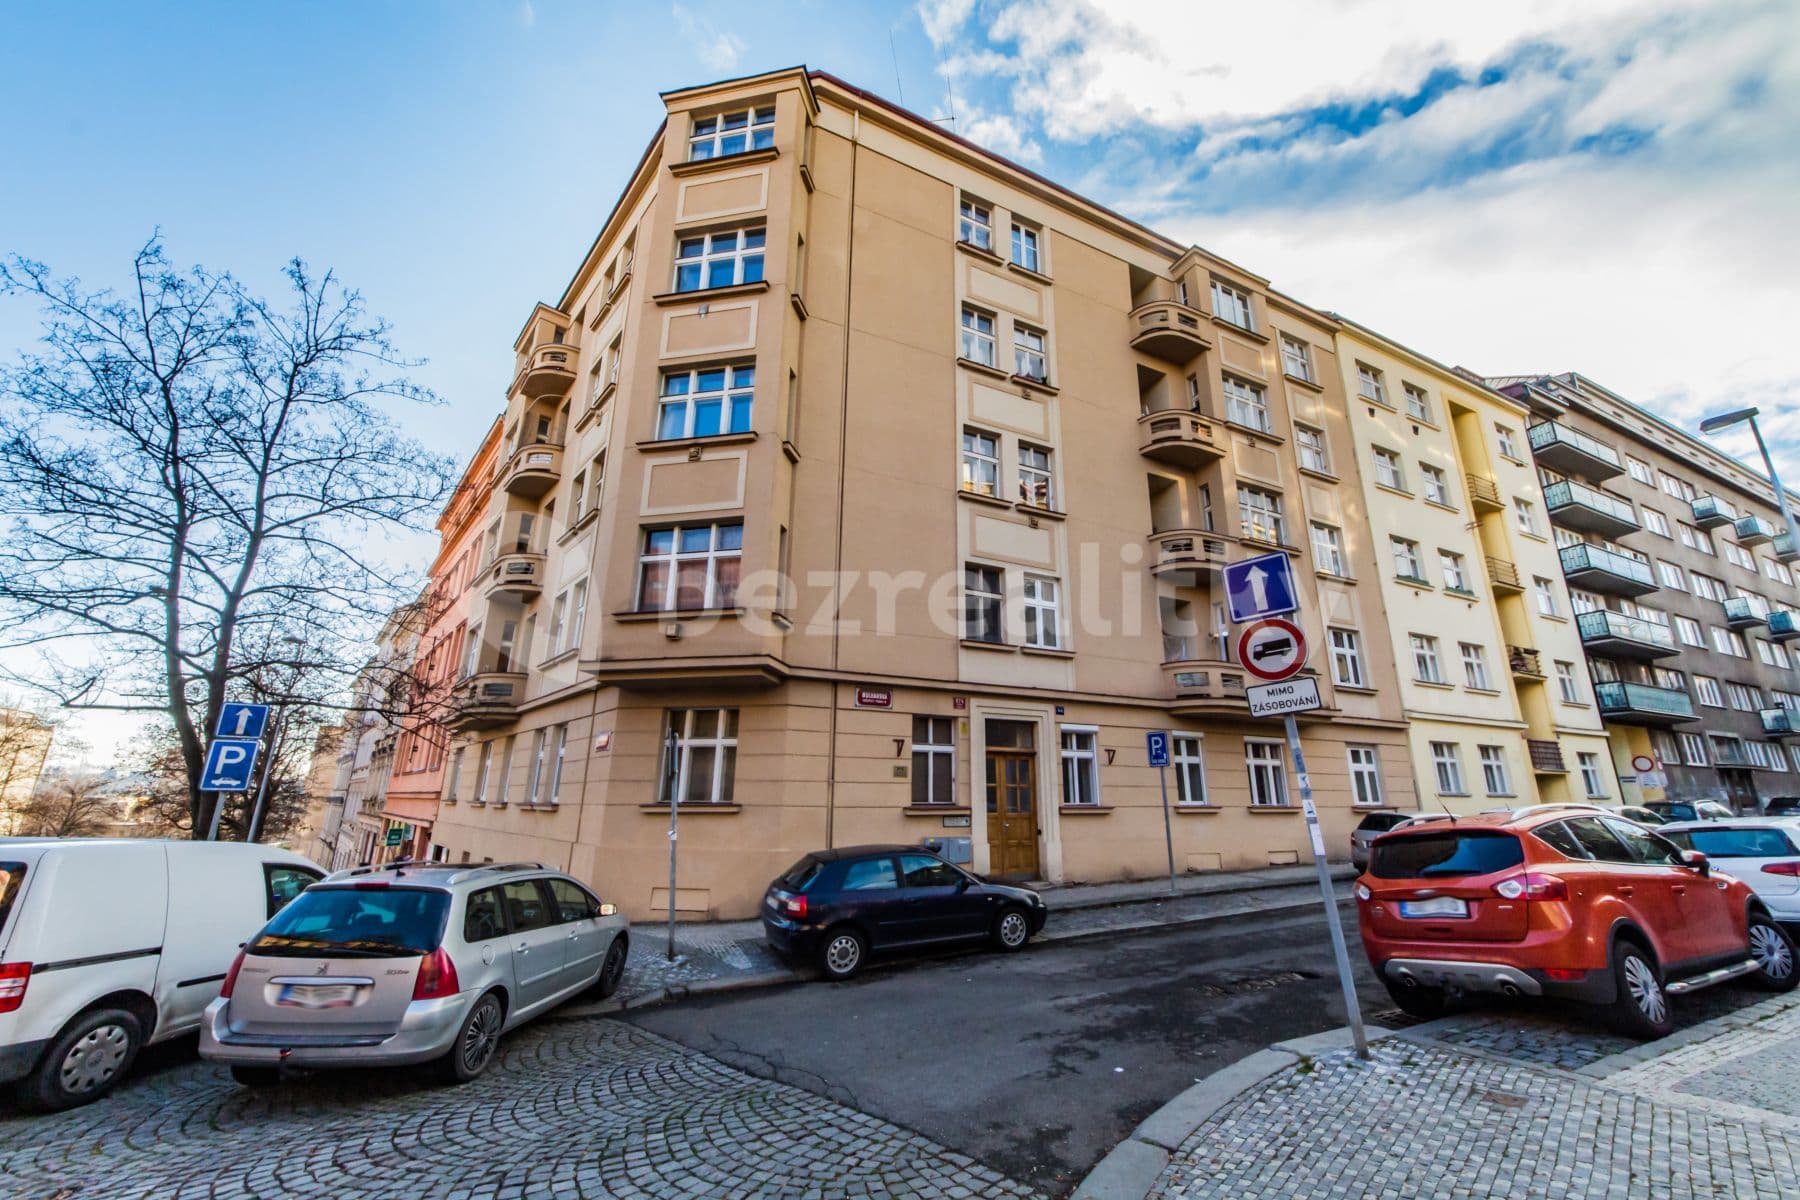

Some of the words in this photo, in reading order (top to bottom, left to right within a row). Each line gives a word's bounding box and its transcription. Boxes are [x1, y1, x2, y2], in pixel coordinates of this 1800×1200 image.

[1266, 685, 1294, 697] MIMO
[1251, 693, 1317, 713] ZÁSOBOVÁNÍ
[1151, 736, 1162, 755] P
[214, 745, 246, 775] P
